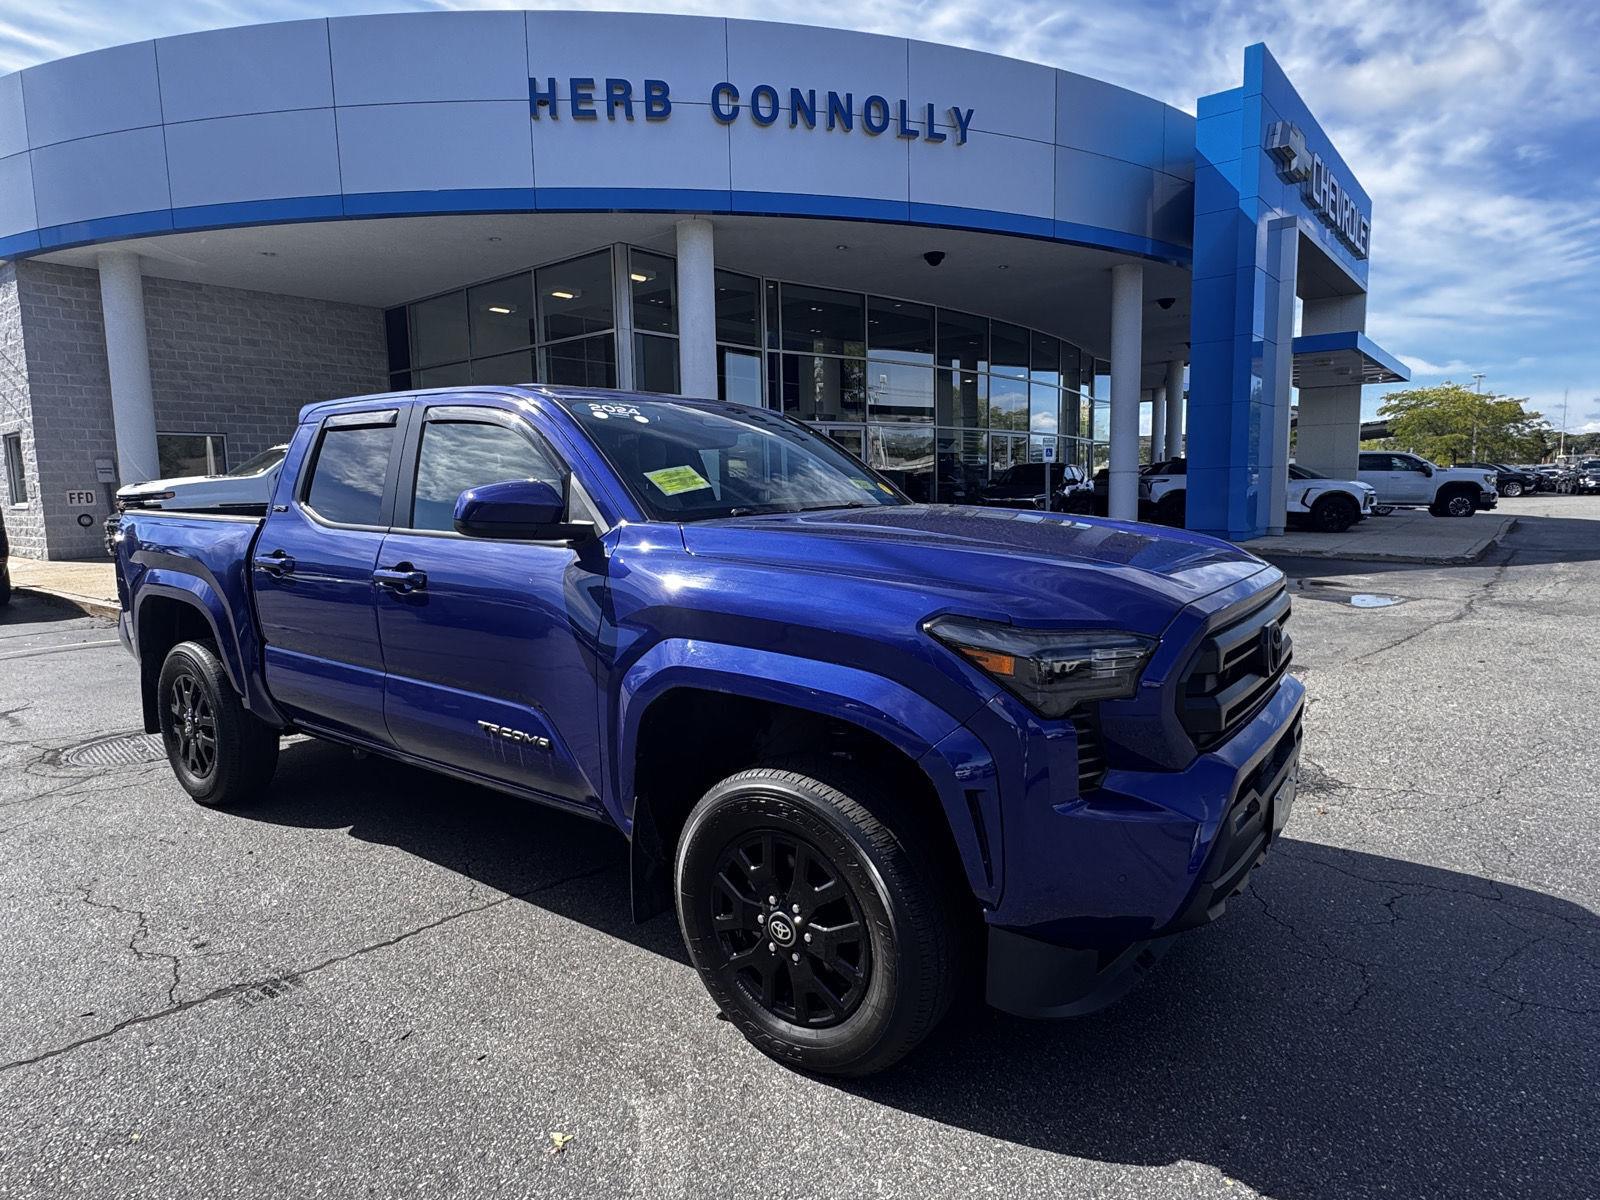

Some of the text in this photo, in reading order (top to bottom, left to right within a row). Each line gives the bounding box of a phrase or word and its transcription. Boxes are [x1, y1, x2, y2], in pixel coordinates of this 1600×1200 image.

[528, 77, 975, 145] HERB CONNOLLY
[1310, 152, 1372, 260] CHEVROLET
[68, 491, 94, 505] FFD
[477, 719, 550, 748] TACOMA
